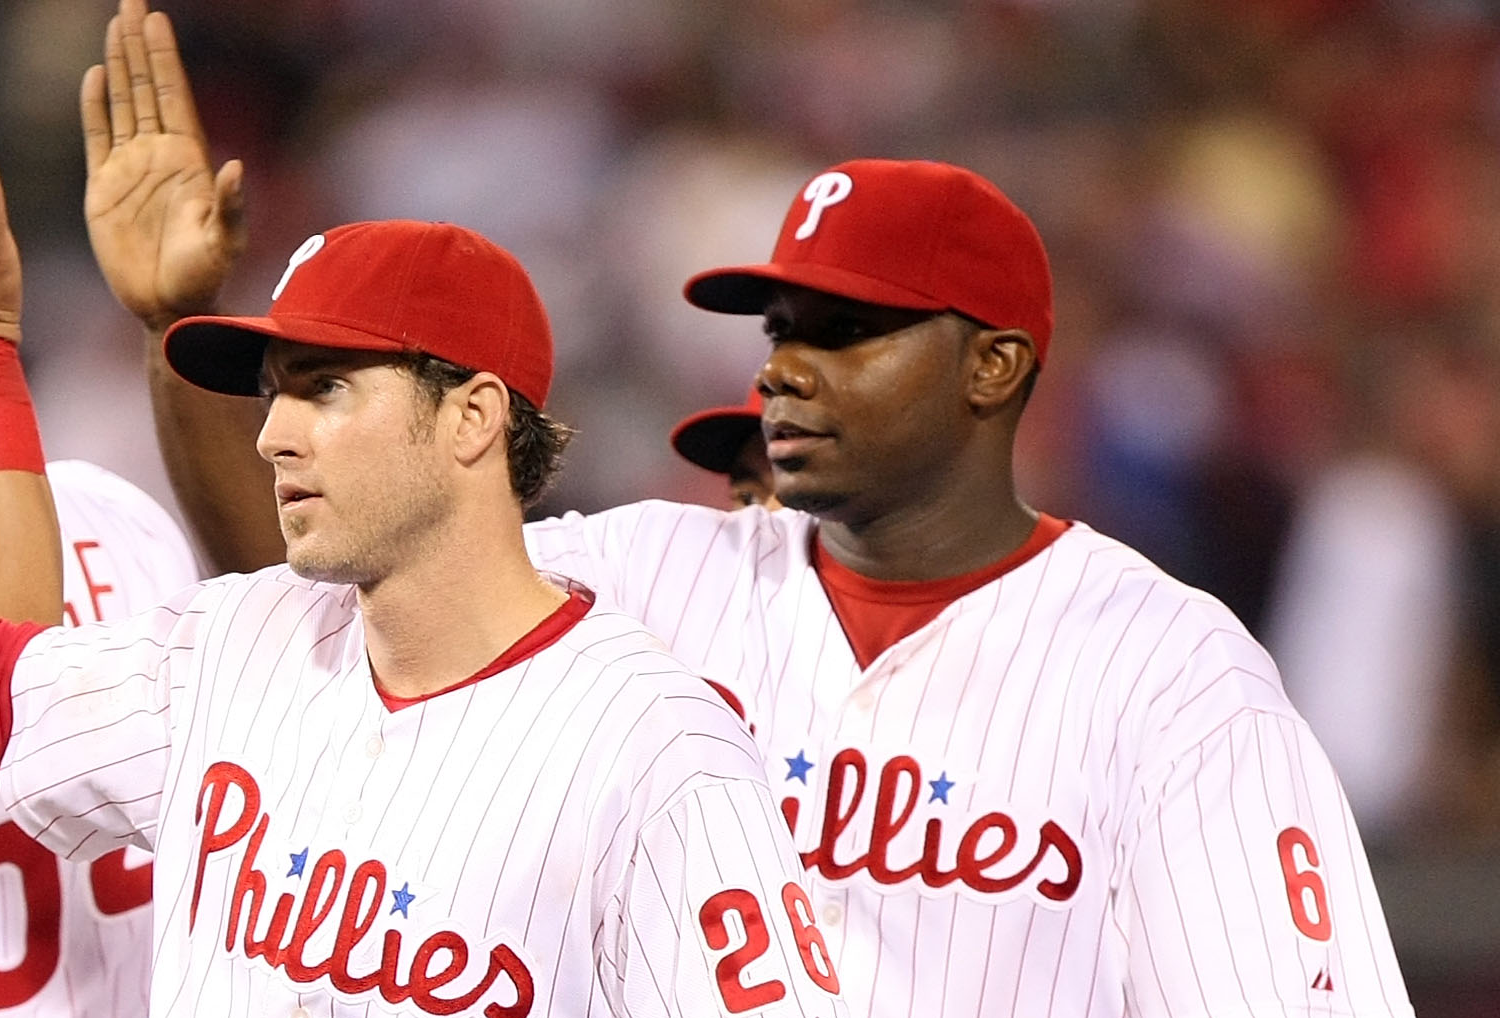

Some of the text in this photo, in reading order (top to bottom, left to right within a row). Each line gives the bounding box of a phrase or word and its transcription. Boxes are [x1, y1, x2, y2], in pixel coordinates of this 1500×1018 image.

[795, 171, 853, 240] P
[271, 233, 325, 301] P
[1277, 826, 1332, 942] 6
[698, 881, 841, 1014] 26
